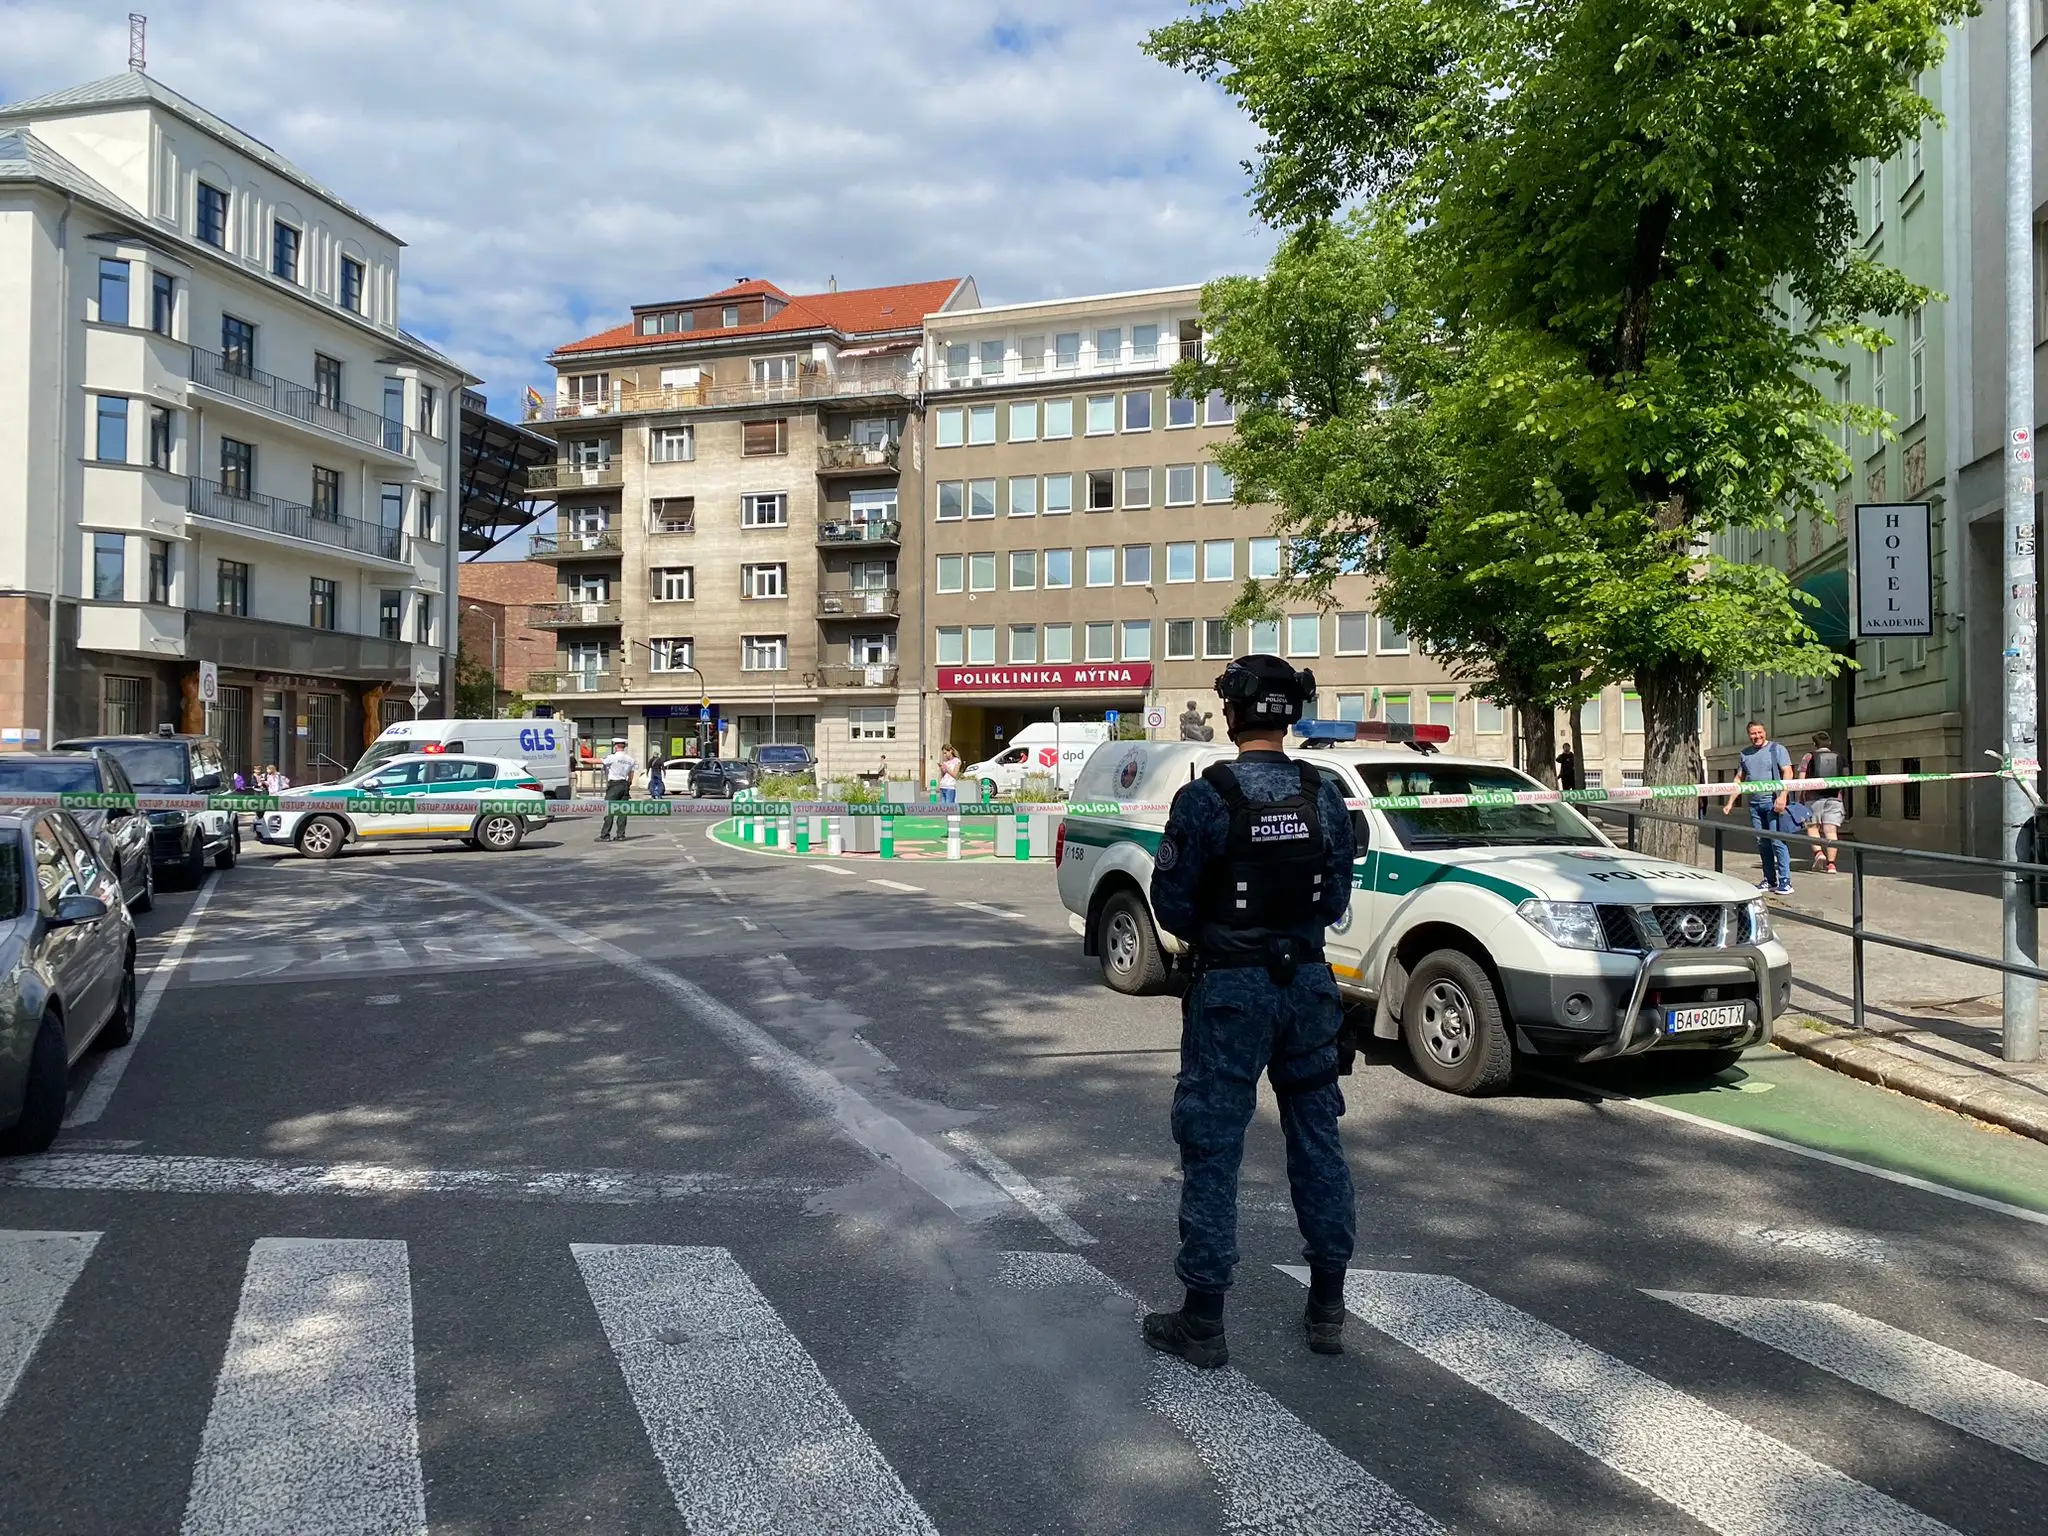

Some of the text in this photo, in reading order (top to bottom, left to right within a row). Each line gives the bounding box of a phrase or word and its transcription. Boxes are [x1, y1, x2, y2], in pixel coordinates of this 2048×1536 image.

[1885, 514, 1900, 611] HOTEL
[1866, 618, 1925, 628] AKADEMIK
[954, 667, 1132, 685] POLIKLINIKA MÝTNA
[386, 727, 410, 735] GLS
[520, 728, 556, 752] GLS
[1062, 749, 1084, 762] dpd
[1372, 796, 1419, 808] POLÍCIA
[1469, 793, 1514, 805] POLÍCIA
[1562, 789, 1606, 801] POLÍCIA
[1653, 785, 1696, 797] POLÍCIA
[62, 794, 133, 808] POLÍCIA
[210, 796, 276, 810] POLÍCIA
[349, 798, 412, 812] POLÍCIA
[482, 800, 543, 814] POLÍCIA
[610, 801, 669, 814] POLÍCIA
[733, 802, 790, 815] POLÍCIA
[850, 803, 904, 814] POLÍCIA
[961, 803, 1013, 814] POLÍCIA
[1068, 802, 1119, 813] POLÍCIA
[1261, 812, 1298, 822] MESTSKÁ
[1251, 821, 1309, 836] POLÍCIA
[1071, 847, 1085, 861] 158
[1588, 869, 1716, 883] POLÍCIA
[1676, 1006, 1743, 1029] BA 805TX
